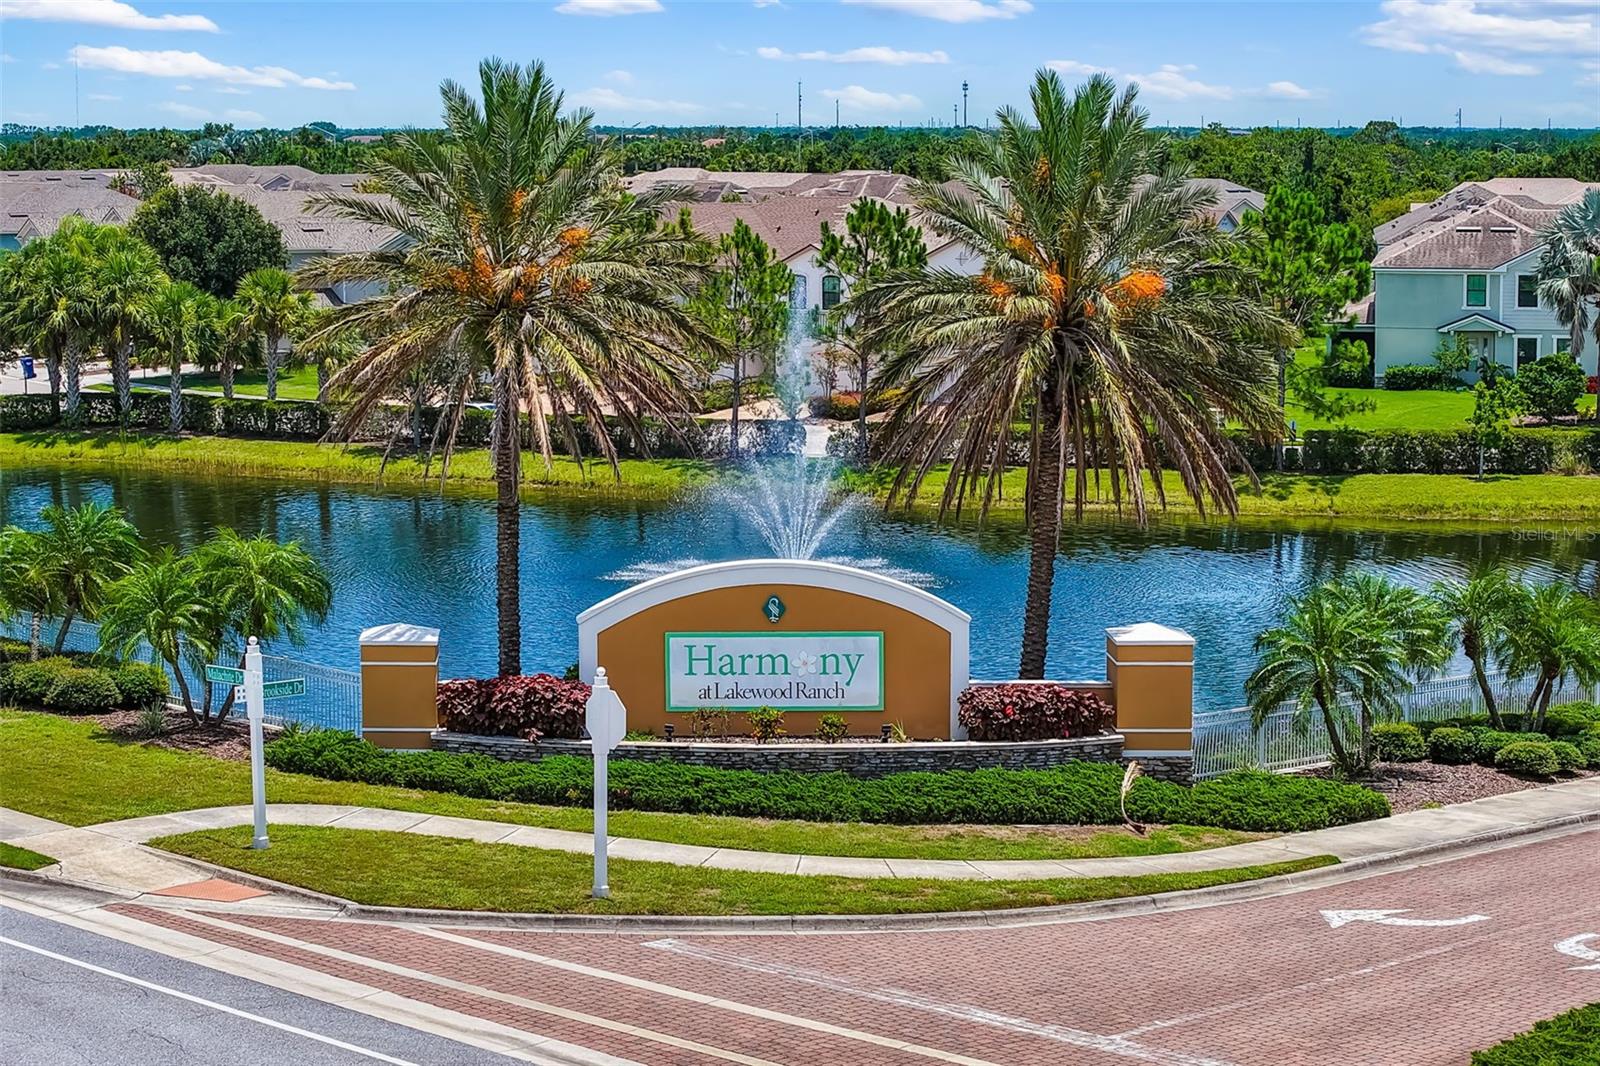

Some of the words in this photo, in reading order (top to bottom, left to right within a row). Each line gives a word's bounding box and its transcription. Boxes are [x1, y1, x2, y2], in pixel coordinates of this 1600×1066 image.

[235, 670, 244, 683] Dr
[264, 684, 293, 699] rookside
[293, 682, 304, 695] Dr
[698, 686, 713, 700] at
[714, 681, 793, 700] Lakewood
[795, 681, 846, 700] Ranch
